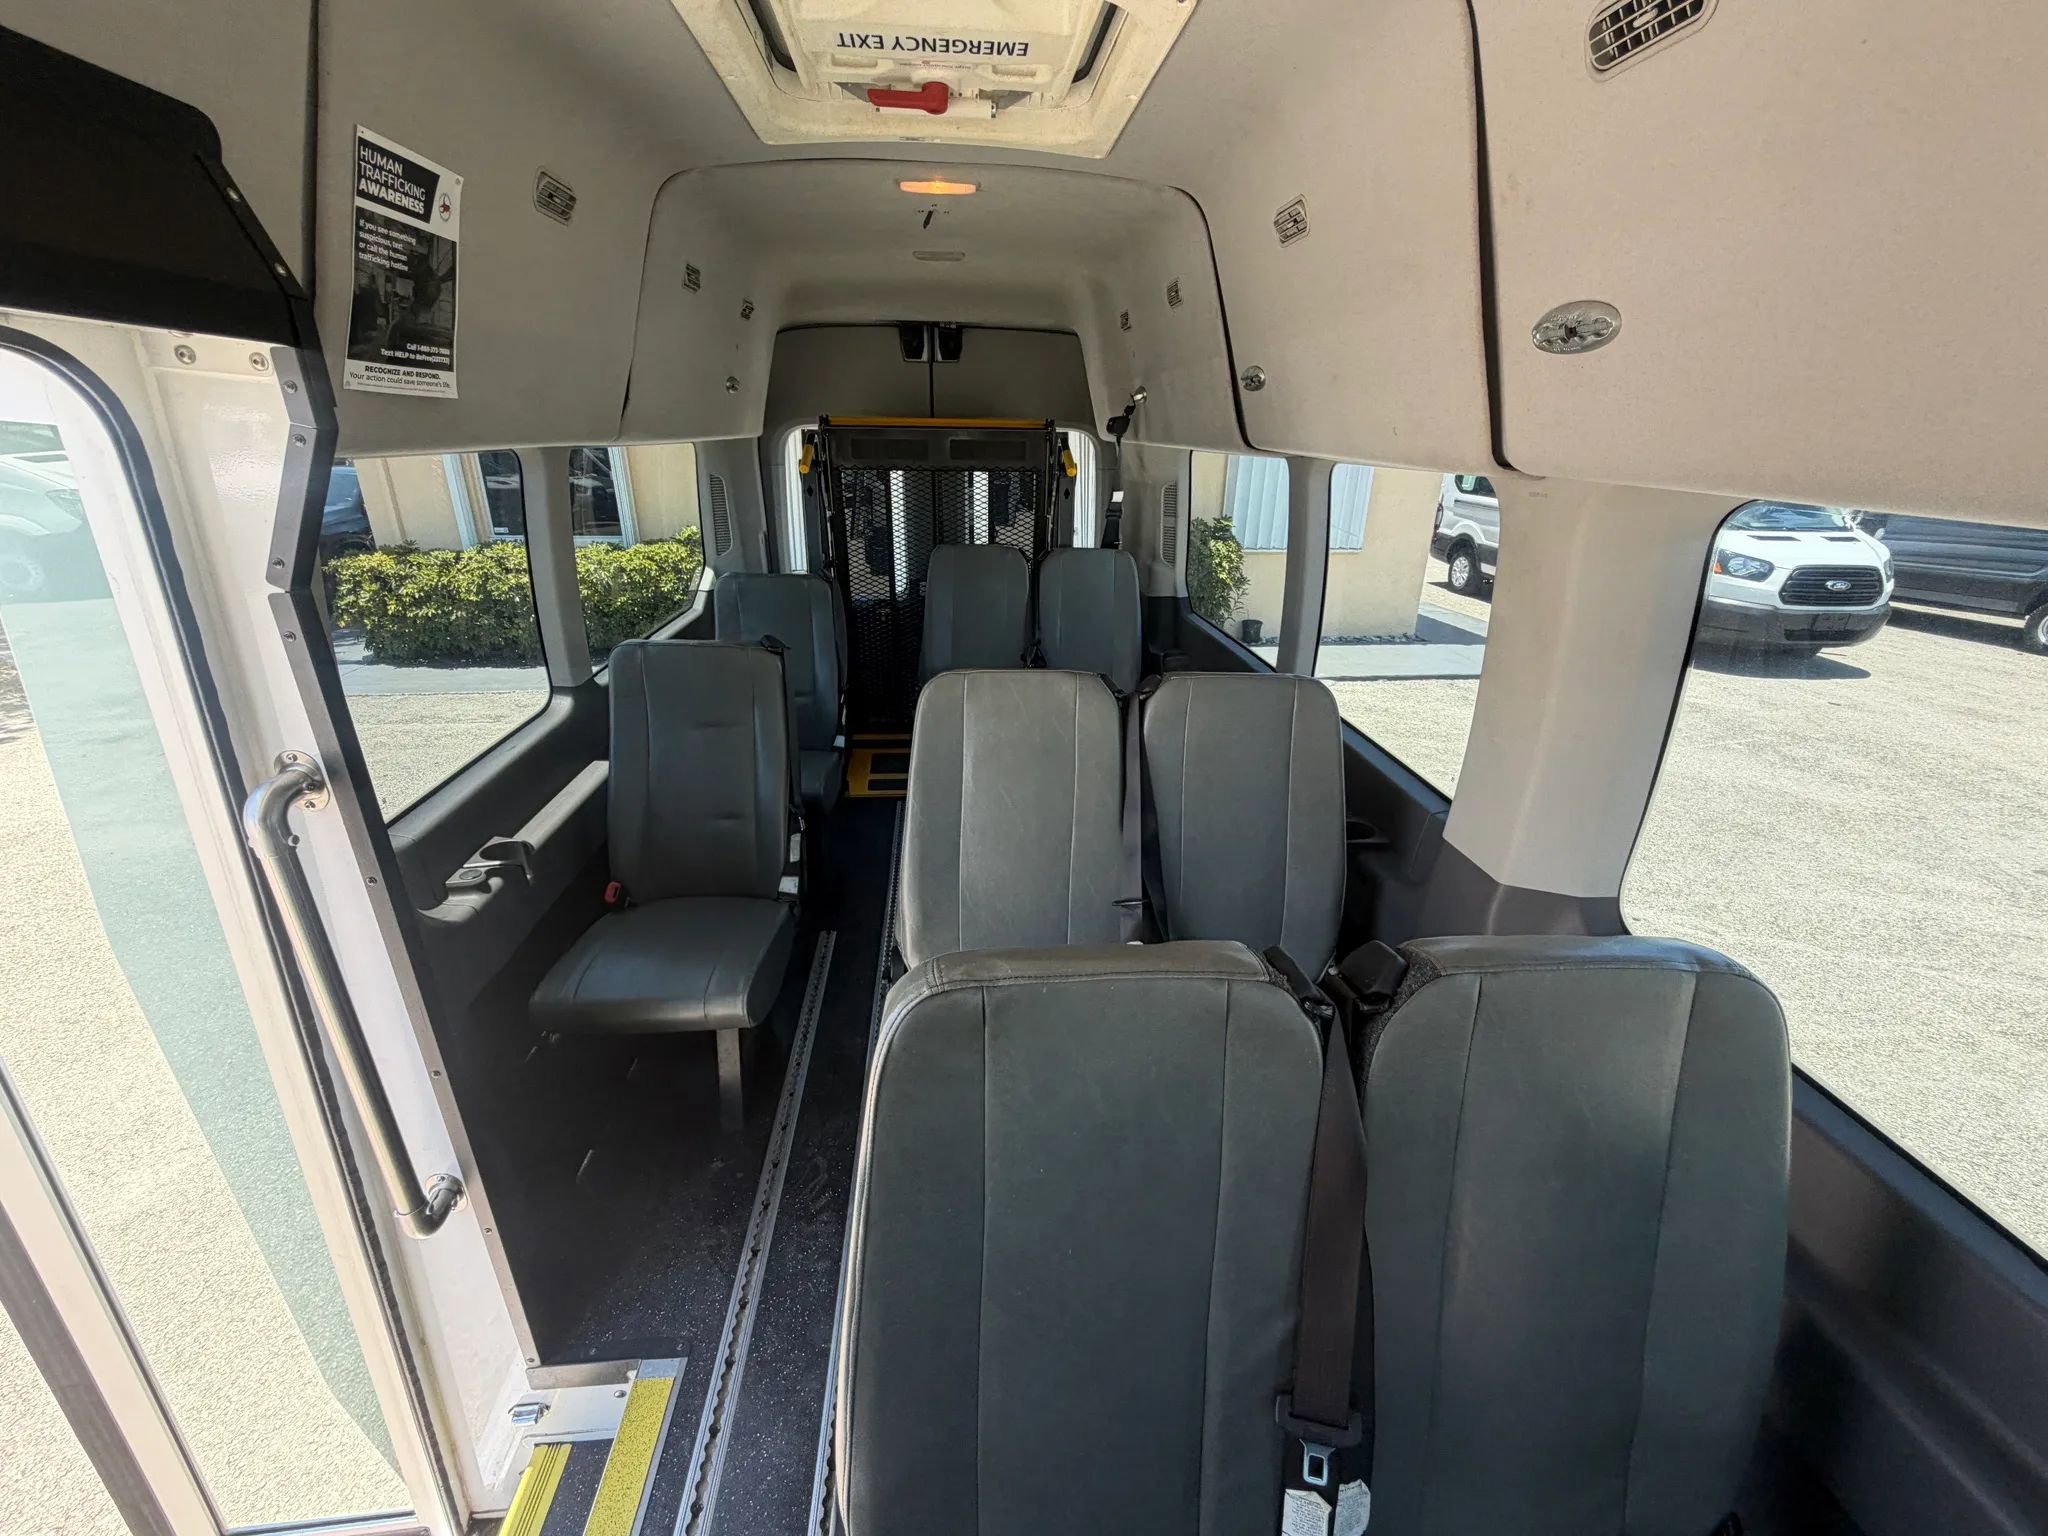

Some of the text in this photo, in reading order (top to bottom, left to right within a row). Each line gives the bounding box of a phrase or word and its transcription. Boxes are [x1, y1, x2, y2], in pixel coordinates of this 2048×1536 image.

[837, 32, 1029, 57] EMERGENCY EXIT
[360, 145, 403, 176] HUMAN
[360, 161, 426, 201] TRAFFICKING
[359, 178, 425, 214] AWARENESS
[365, 222, 376, 231] you
[377, 226, 388, 235] see
[389, 230, 416, 246] something
[359, 252, 390, 268] trafficking
[367, 244, 377, 253] call
[379, 247, 388, 256] the
[390, 250, 407, 261] human
[381, 348, 393, 357] Text
[407, 343, 417, 351] Call
[349, 371, 365, 380] Your
[365, 374, 386, 383] action
[386, 376, 403, 384] could
[416, 379, 442, 388] someone's
[365, 365, 401, 376] RECOGNIZE
[415, 371, 441, 380] RESPOND.
